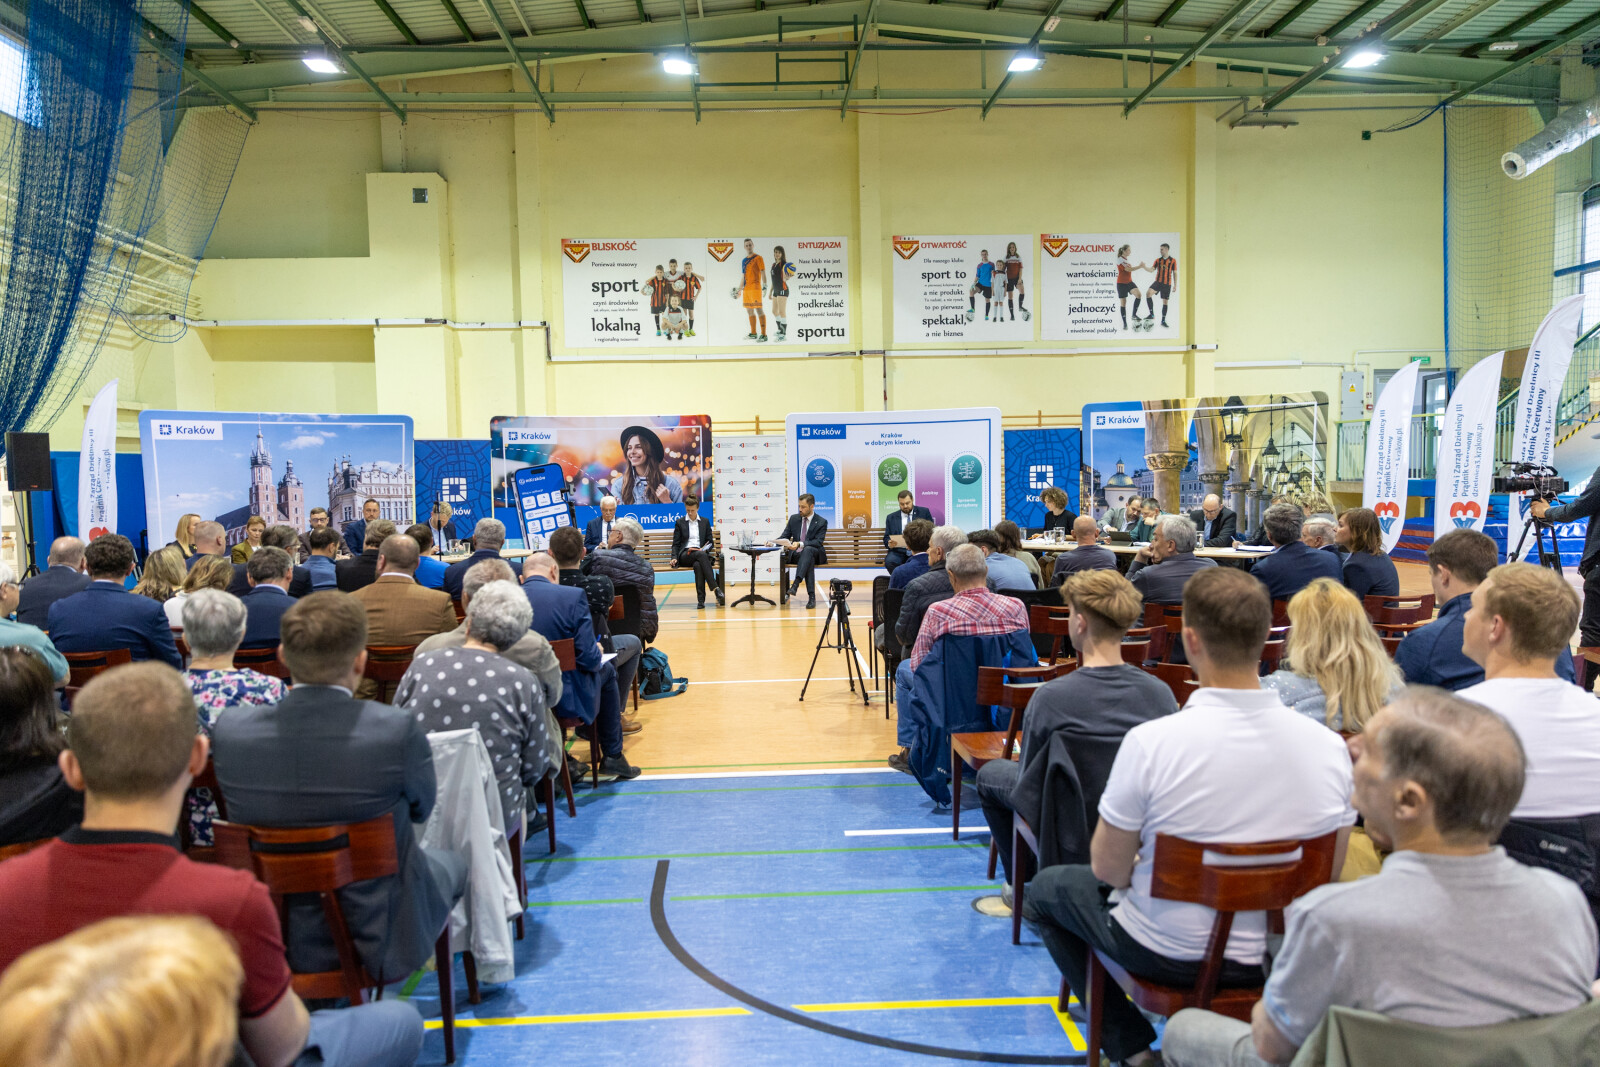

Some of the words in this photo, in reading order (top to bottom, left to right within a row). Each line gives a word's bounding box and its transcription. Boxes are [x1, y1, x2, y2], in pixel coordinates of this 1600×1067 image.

[592, 240, 638, 250] BLISKOŚĆ
[798, 242, 842, 250] ENTUZJAZM
[920, 240, 967, 248] OTWARTOŚĆ
[1070, 244, 1115, 252] SZACUNEK
[798, 268, 842, 282] zwykłym
[922, 270, 951, 282] sport
[955, 270, 966, 278] to
[1066, 270, 1118, 278] wartościami:
[592, 279, 639, 298] sport
[798, 299, 844, 310] podkreślać
[1068, 303, 1116, 316] jednoczyć
[591, 317, 640, 335] lokalną
[922, 314, 966, 328] spektakl,
[798, 326, 845, 342] sportu
[1523, 408, 1532, 439] Zarząd
[1528, 362, 1540, 405] Dzielnicy
[1531, 388, 1546, 434] Czerwony
[1108, 416, 1140, 424] Kraków
[176, 426, 215, 434] Kraków
[521, 432, 552, 440] Kraków
[1378, 418, 1386, 450] Dzielnicy
[1454, 414, 1464, 447] Dzielnicy
[871, 440, 894, 448] dobrym
[1464, 432, 1474, 468] Czerwony
[1384, 436, 1393, 470] Czerwony
[1454, 448, 1462, 474] Zarząd
[1462, 469, 1470, 497] Prądnik
[452, 507, 471, 516] ków
[640, 512, 686, 524] mKrakó
